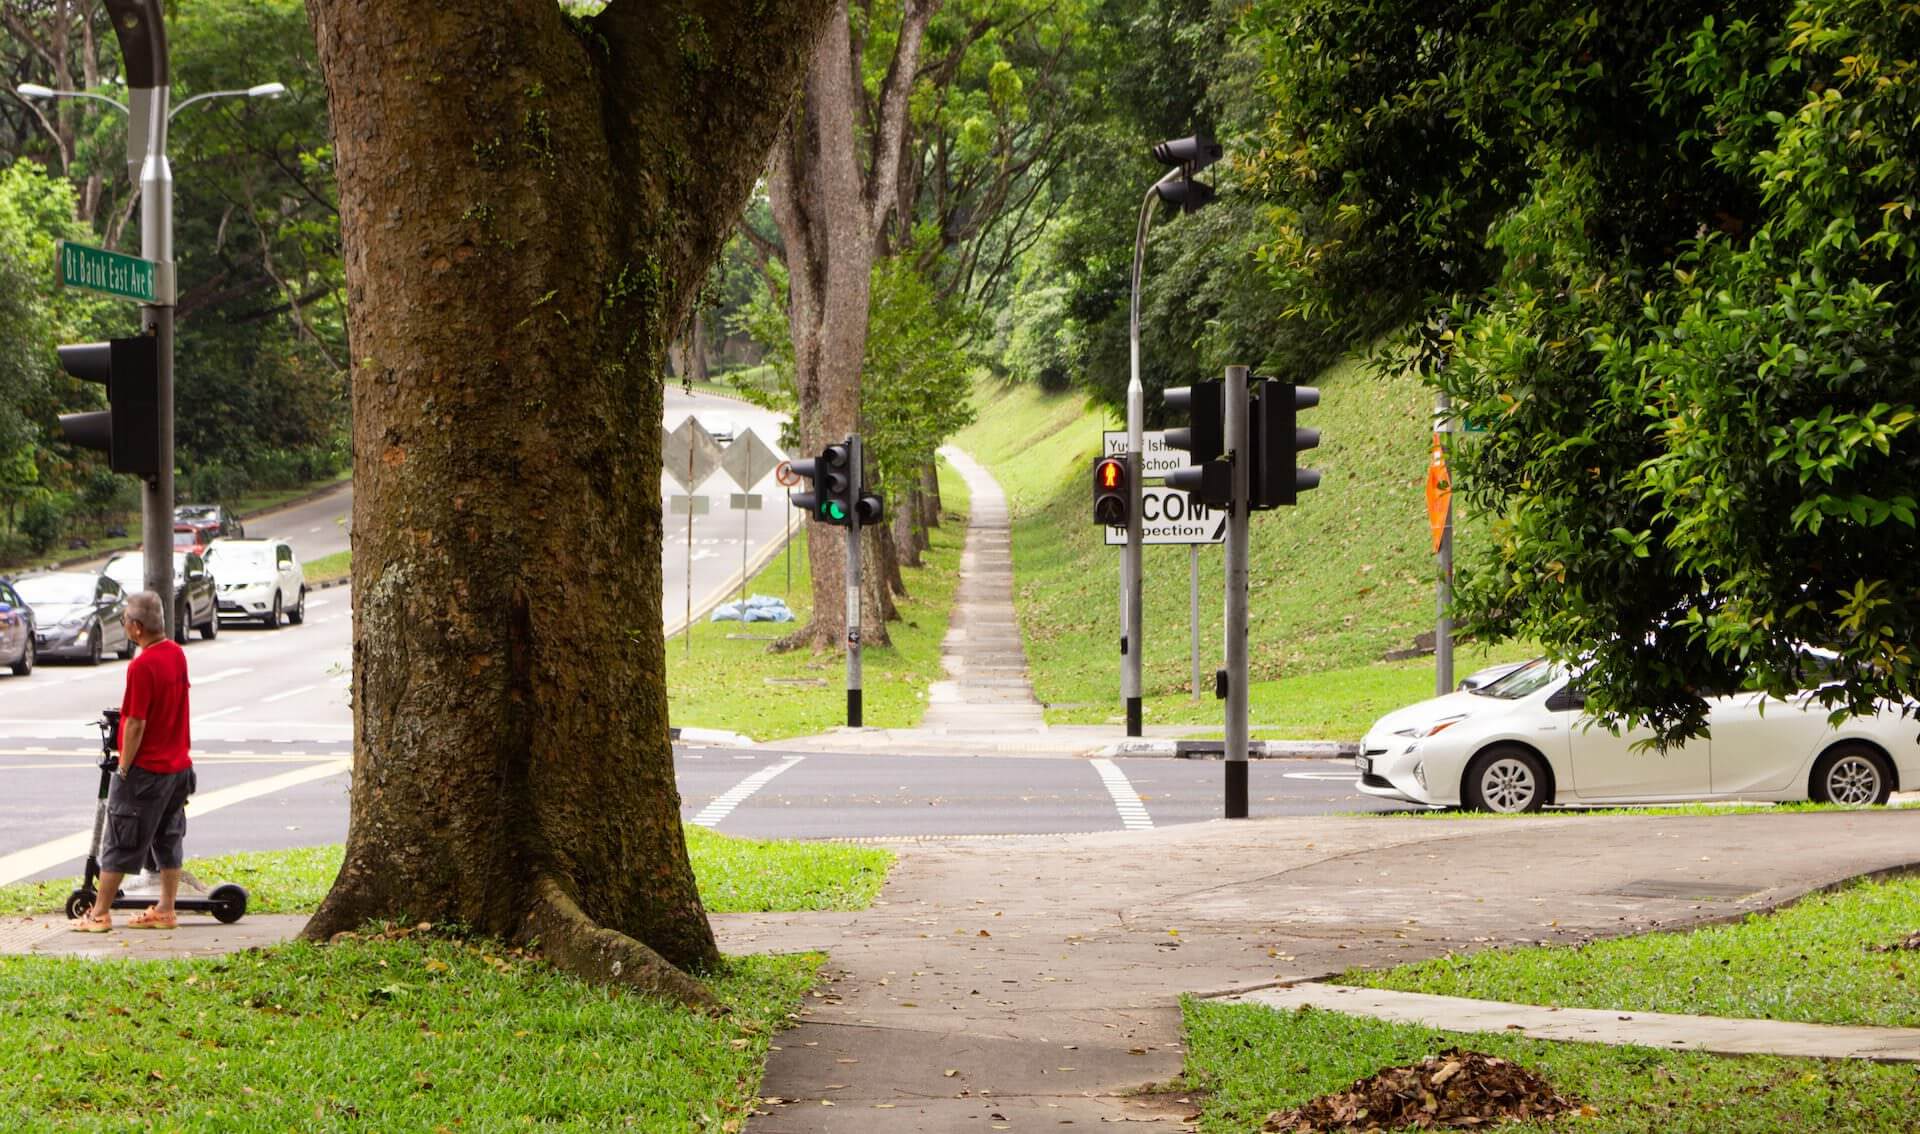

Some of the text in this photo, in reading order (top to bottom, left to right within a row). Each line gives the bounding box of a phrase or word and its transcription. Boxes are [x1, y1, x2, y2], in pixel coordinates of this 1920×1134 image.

[66, 246, 153, 297] Bt Batok East Ave 6
